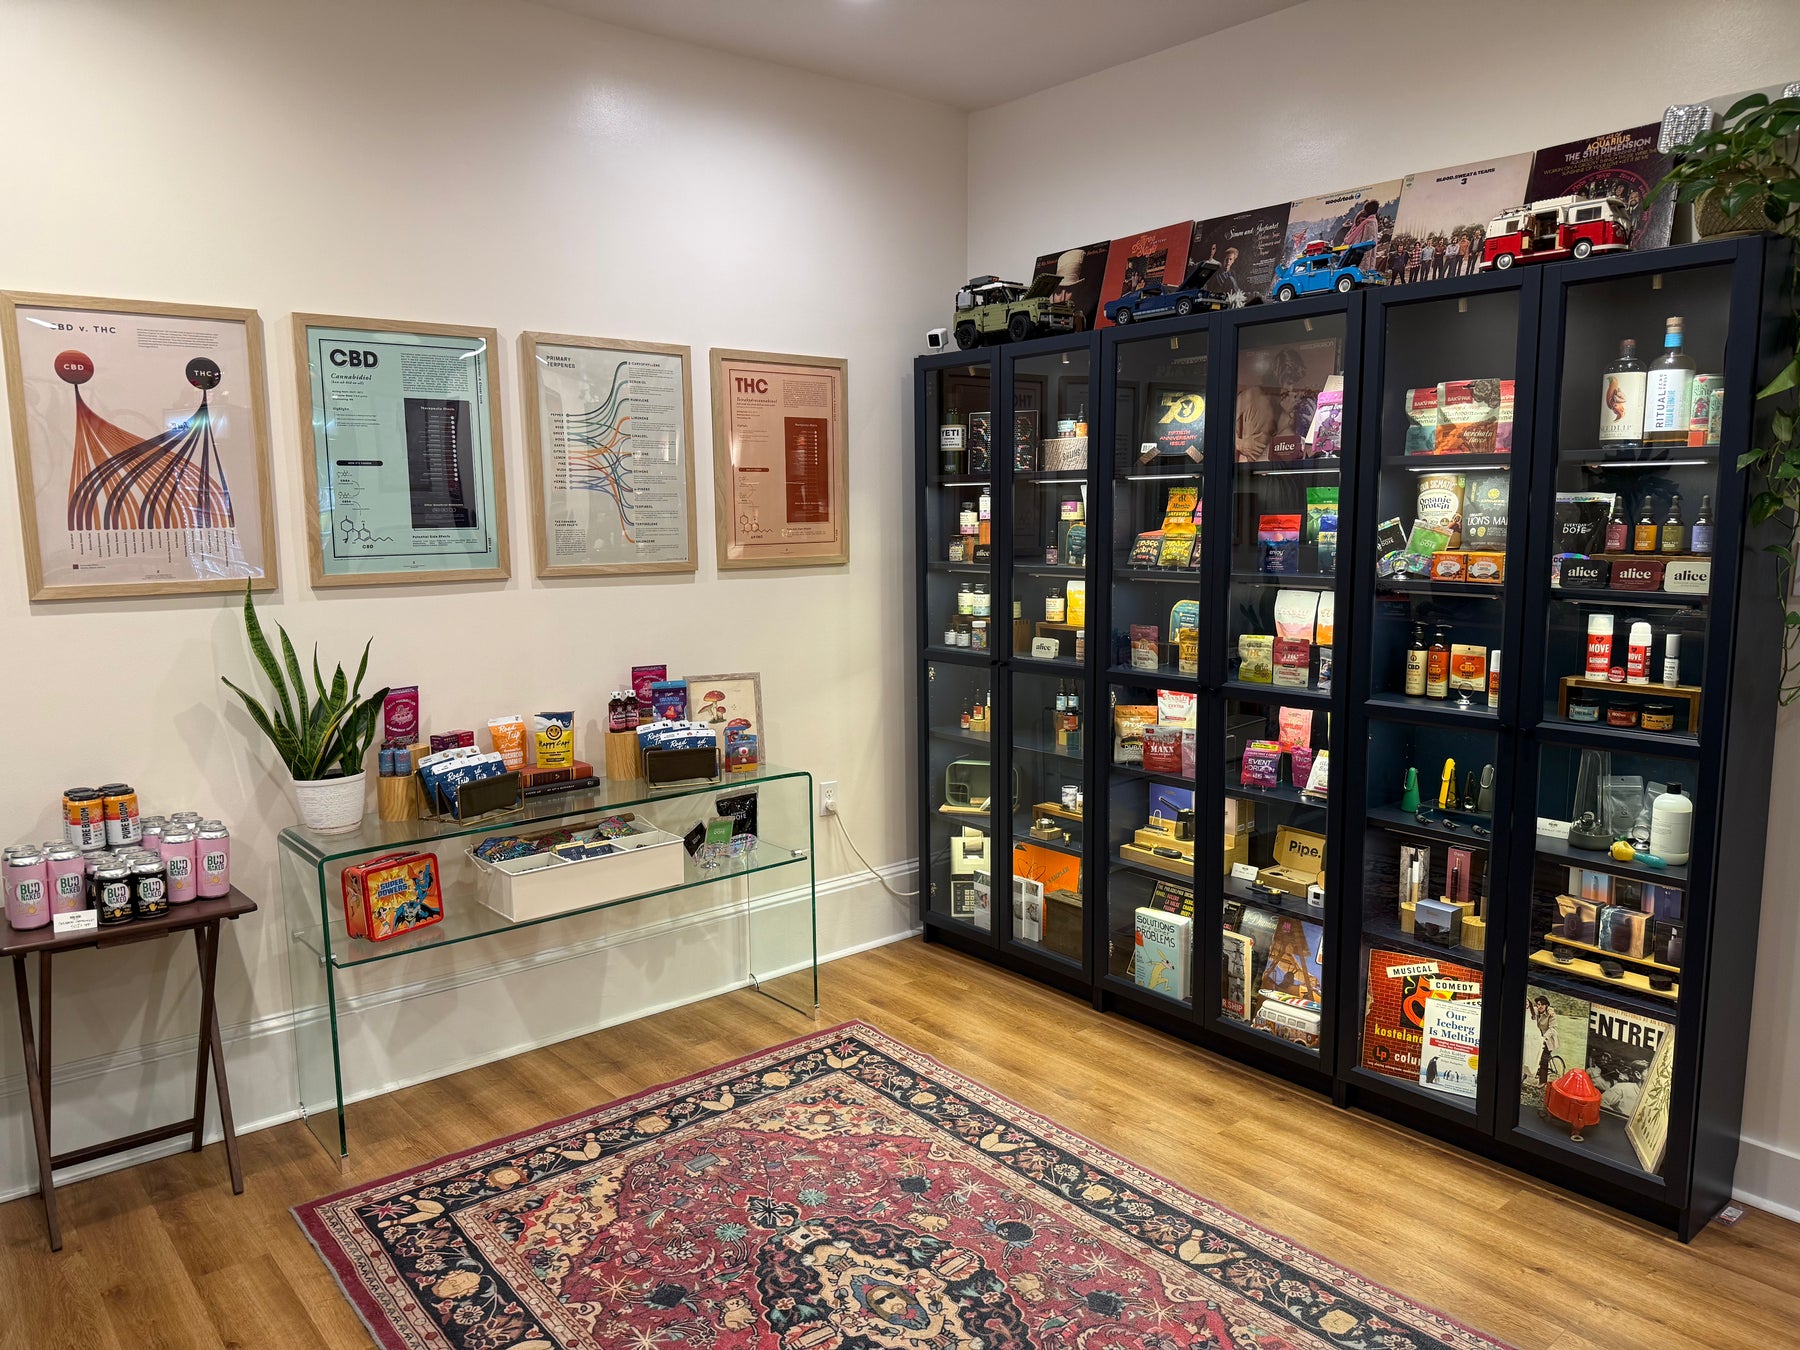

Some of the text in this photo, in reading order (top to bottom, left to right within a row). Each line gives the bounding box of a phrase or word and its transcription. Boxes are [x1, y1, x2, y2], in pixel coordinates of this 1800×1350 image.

[1586, 134, 1631, 151] AQUARIUS
[1565, 137, 1652, 162] THE 5TH DIMENSION
[1325, 194, 1355, 205] woodstock
[1224, 226, 1243, 240] Simon
[50, 322, 74, 332] CBD
[93, 325, 117, 334] THC
[329, 348, 379, 368] CBD
[63, 363, 85, 372] CBD
[193, 369, 212, 378] THC
[330, 373, 372, 381] Cannabidiol
[735, 377, 769, 394] THC
[1655, 390, 1667, 428] RITUAL
[941, 429, 960, 437] YETI
[1274, 441, 1295, 452] alice
[1419, 495, 1452, 505] organic
[1420, 501, 1450, 512] protein
[1467, 515, 1490, 526] LION'S
[1568, 566, 1598, 578] alice
[1619, 567, 1652, 579] alice
[1674, 570, 1707, 581] alice
[1588, 643, 1610, 653] MOVE
[1460, 664, 1475, 672] CBD
[498, 723, 517, 733] Road
[506, 731, 520, 740] Trip
[538, 741, 556, 749] Happy
[670, 739, 687, 748] Road
[1150, 745, 1175, 753] MAXX
[1248, 758, 1273, 766] EVENT
[447, 769, 466, 781] Road
[1244, 765, 1276, 774] HORIZON
[457, 776, 470, 785] Trip
[80, 807, 90, 828] BLOOM
[119, 802, 129, 822] BLOOM
[122, 821, 131, 840] PURE
[82, 827, 92, 846] PURE
[1289, 840, 1321, 859] Pipe.
[169, 859, 188, 870] BUD
[207, 854, 225, 865] BUD
[169, 867, 189, 877] NAKED
[207, 862, 225, 872] NAKED
[20, 881, 41, 893] BUD
[60, 875, 80, 888] BUD
[142, 880, 161, 893] BUD
[380, 878, 404, 890] SUPER
[61, 885, 81, 895] NAKED
[107, 885, 126, 898] BUD
[142, 890, 162, 900] NAKED
[377, 884, 408, 898] POWERS
[20, 891, 41, 902] NAKED
[107, 896, 127, 906] NAKED
[1136, 915, 1175, 934] SOLUTIONS
[1136, 926, 1176, 948] PROBLEMS
[1392, 965, 1433, 976] MUSICAL
[1435, 981, 1474, 992] COMEDY
[1227, 1001, 1243, 1013] SHIP
[1445, 1010, 1467, 1022] Our
[1436, 1018, 1475, 1035] Iceberg
[1374, 1023, 1424, 1044] kostelane
[1429, 1027, 1480, 1046] Is Melting
[1376, 1046, 1387, 1061] Lp
